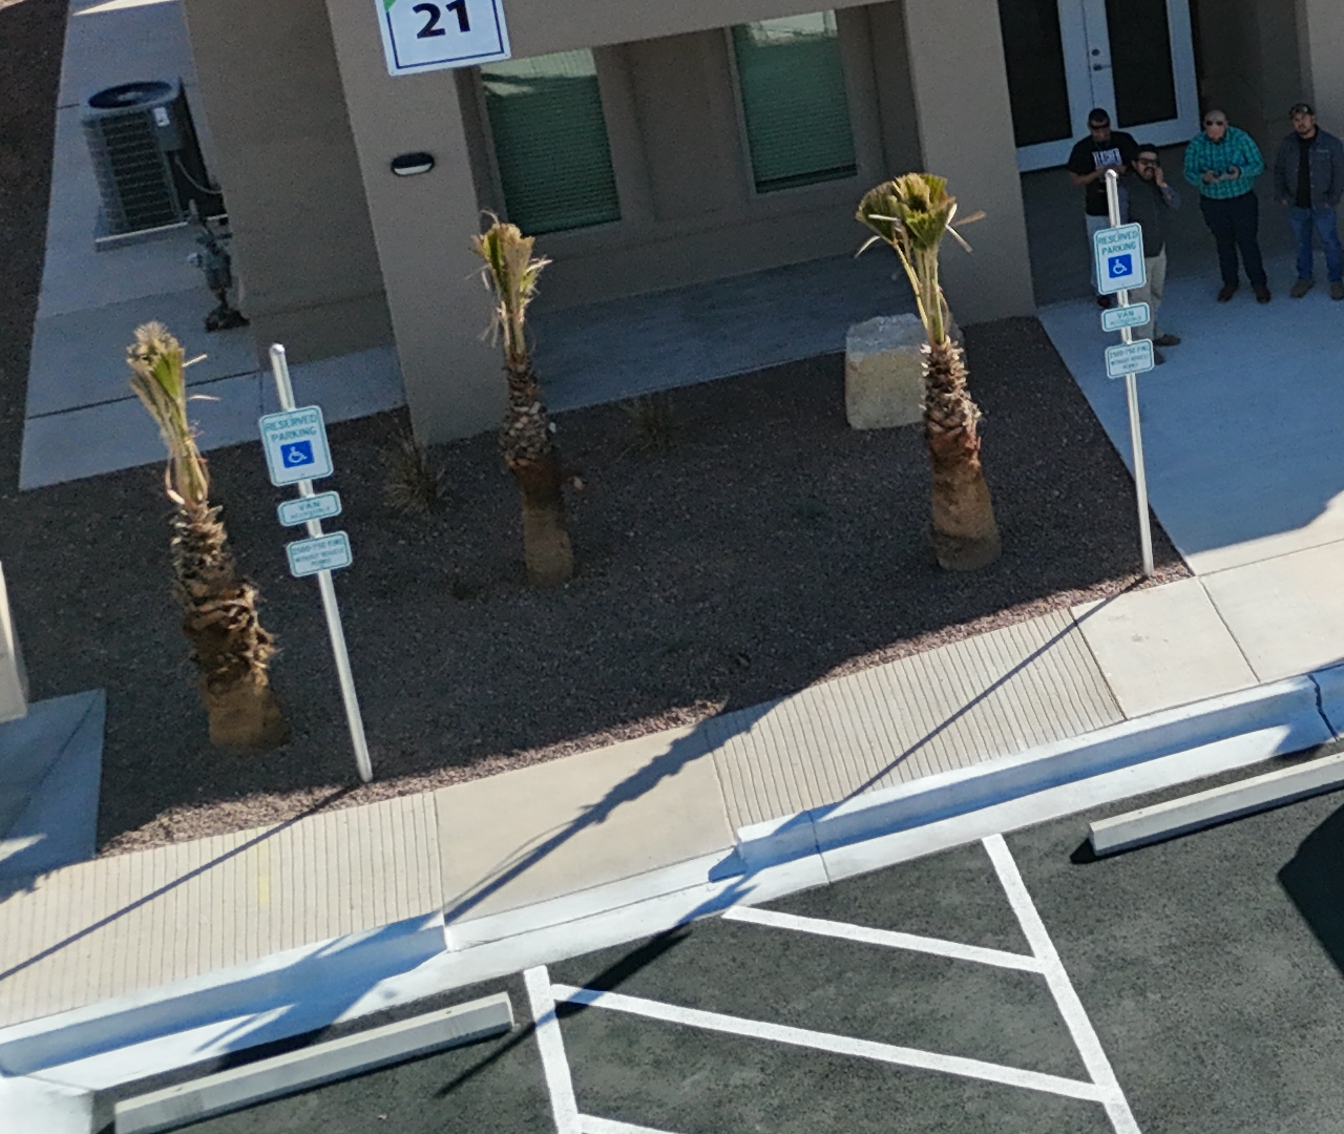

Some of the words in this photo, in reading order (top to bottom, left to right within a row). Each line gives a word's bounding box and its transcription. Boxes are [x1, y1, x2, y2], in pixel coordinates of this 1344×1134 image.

[1098, 230, 1139, 246] RESERVED
[1101, 241, 1137, 256] PARKING
[1117, 310, 1135, 319] VAN
[266, 414, 318, 430] RESERVED
[271, 426, 317, 442] PARKING
[298, 501, 320, 511] VAN
